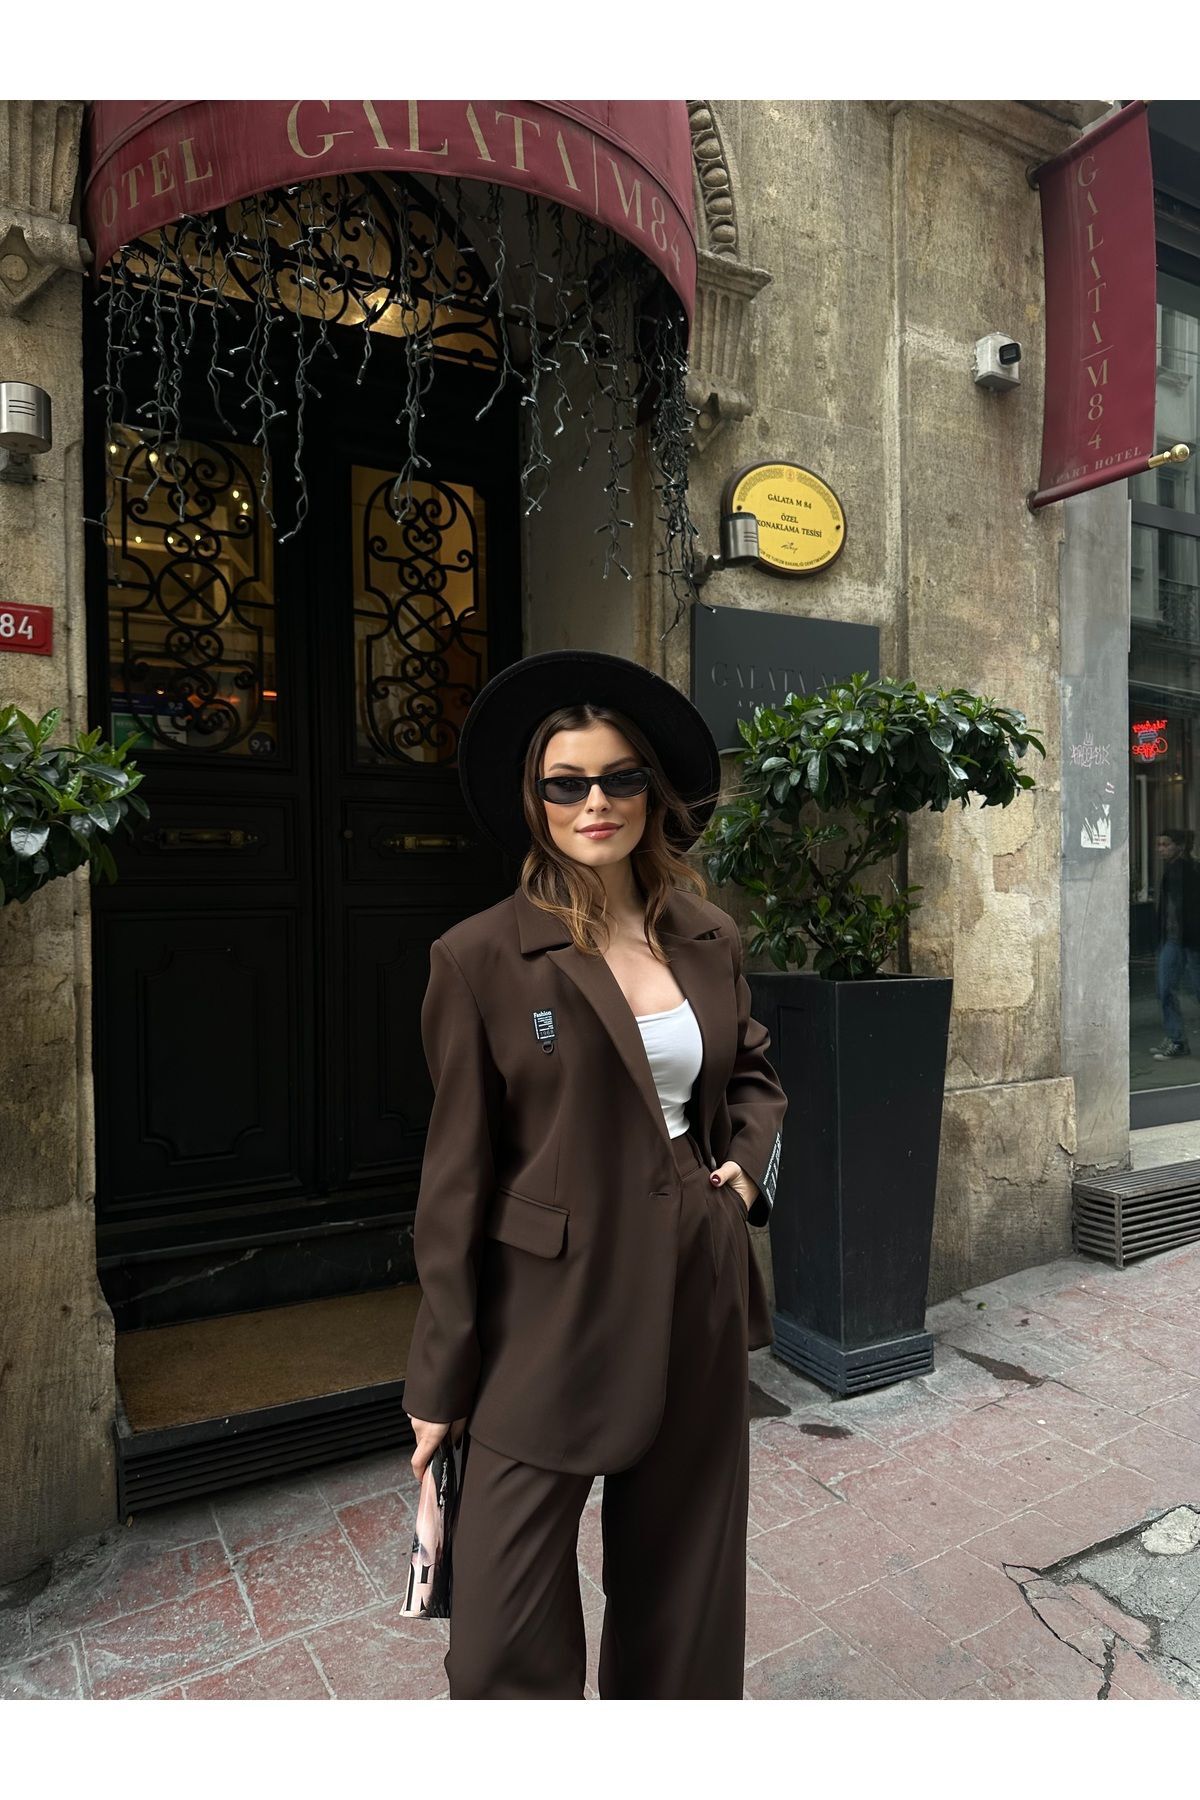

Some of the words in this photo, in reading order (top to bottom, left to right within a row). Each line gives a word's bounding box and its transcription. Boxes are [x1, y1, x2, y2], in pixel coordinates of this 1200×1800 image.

[287, 100, 581, 192] GALATA
[608, 157, 682, 277] M84
[1077, 156, 1107, 344] GALATA
[1095, 447, 1142, 470] HOTEL
[767, 493, 794, 506] GALATA
[796, 499, 802, 507] M
[804, 501, 812, 509] 84
[781, 512, 799, 524] ÖZEL
[801, 527, 823, 538] TESİSİ
[0, 613, 33, 640] 84
[711, 660, 806, 694] GALATA
[737, 700, 777, 710] APAR
[251, 740, 272, 752] 9,1
